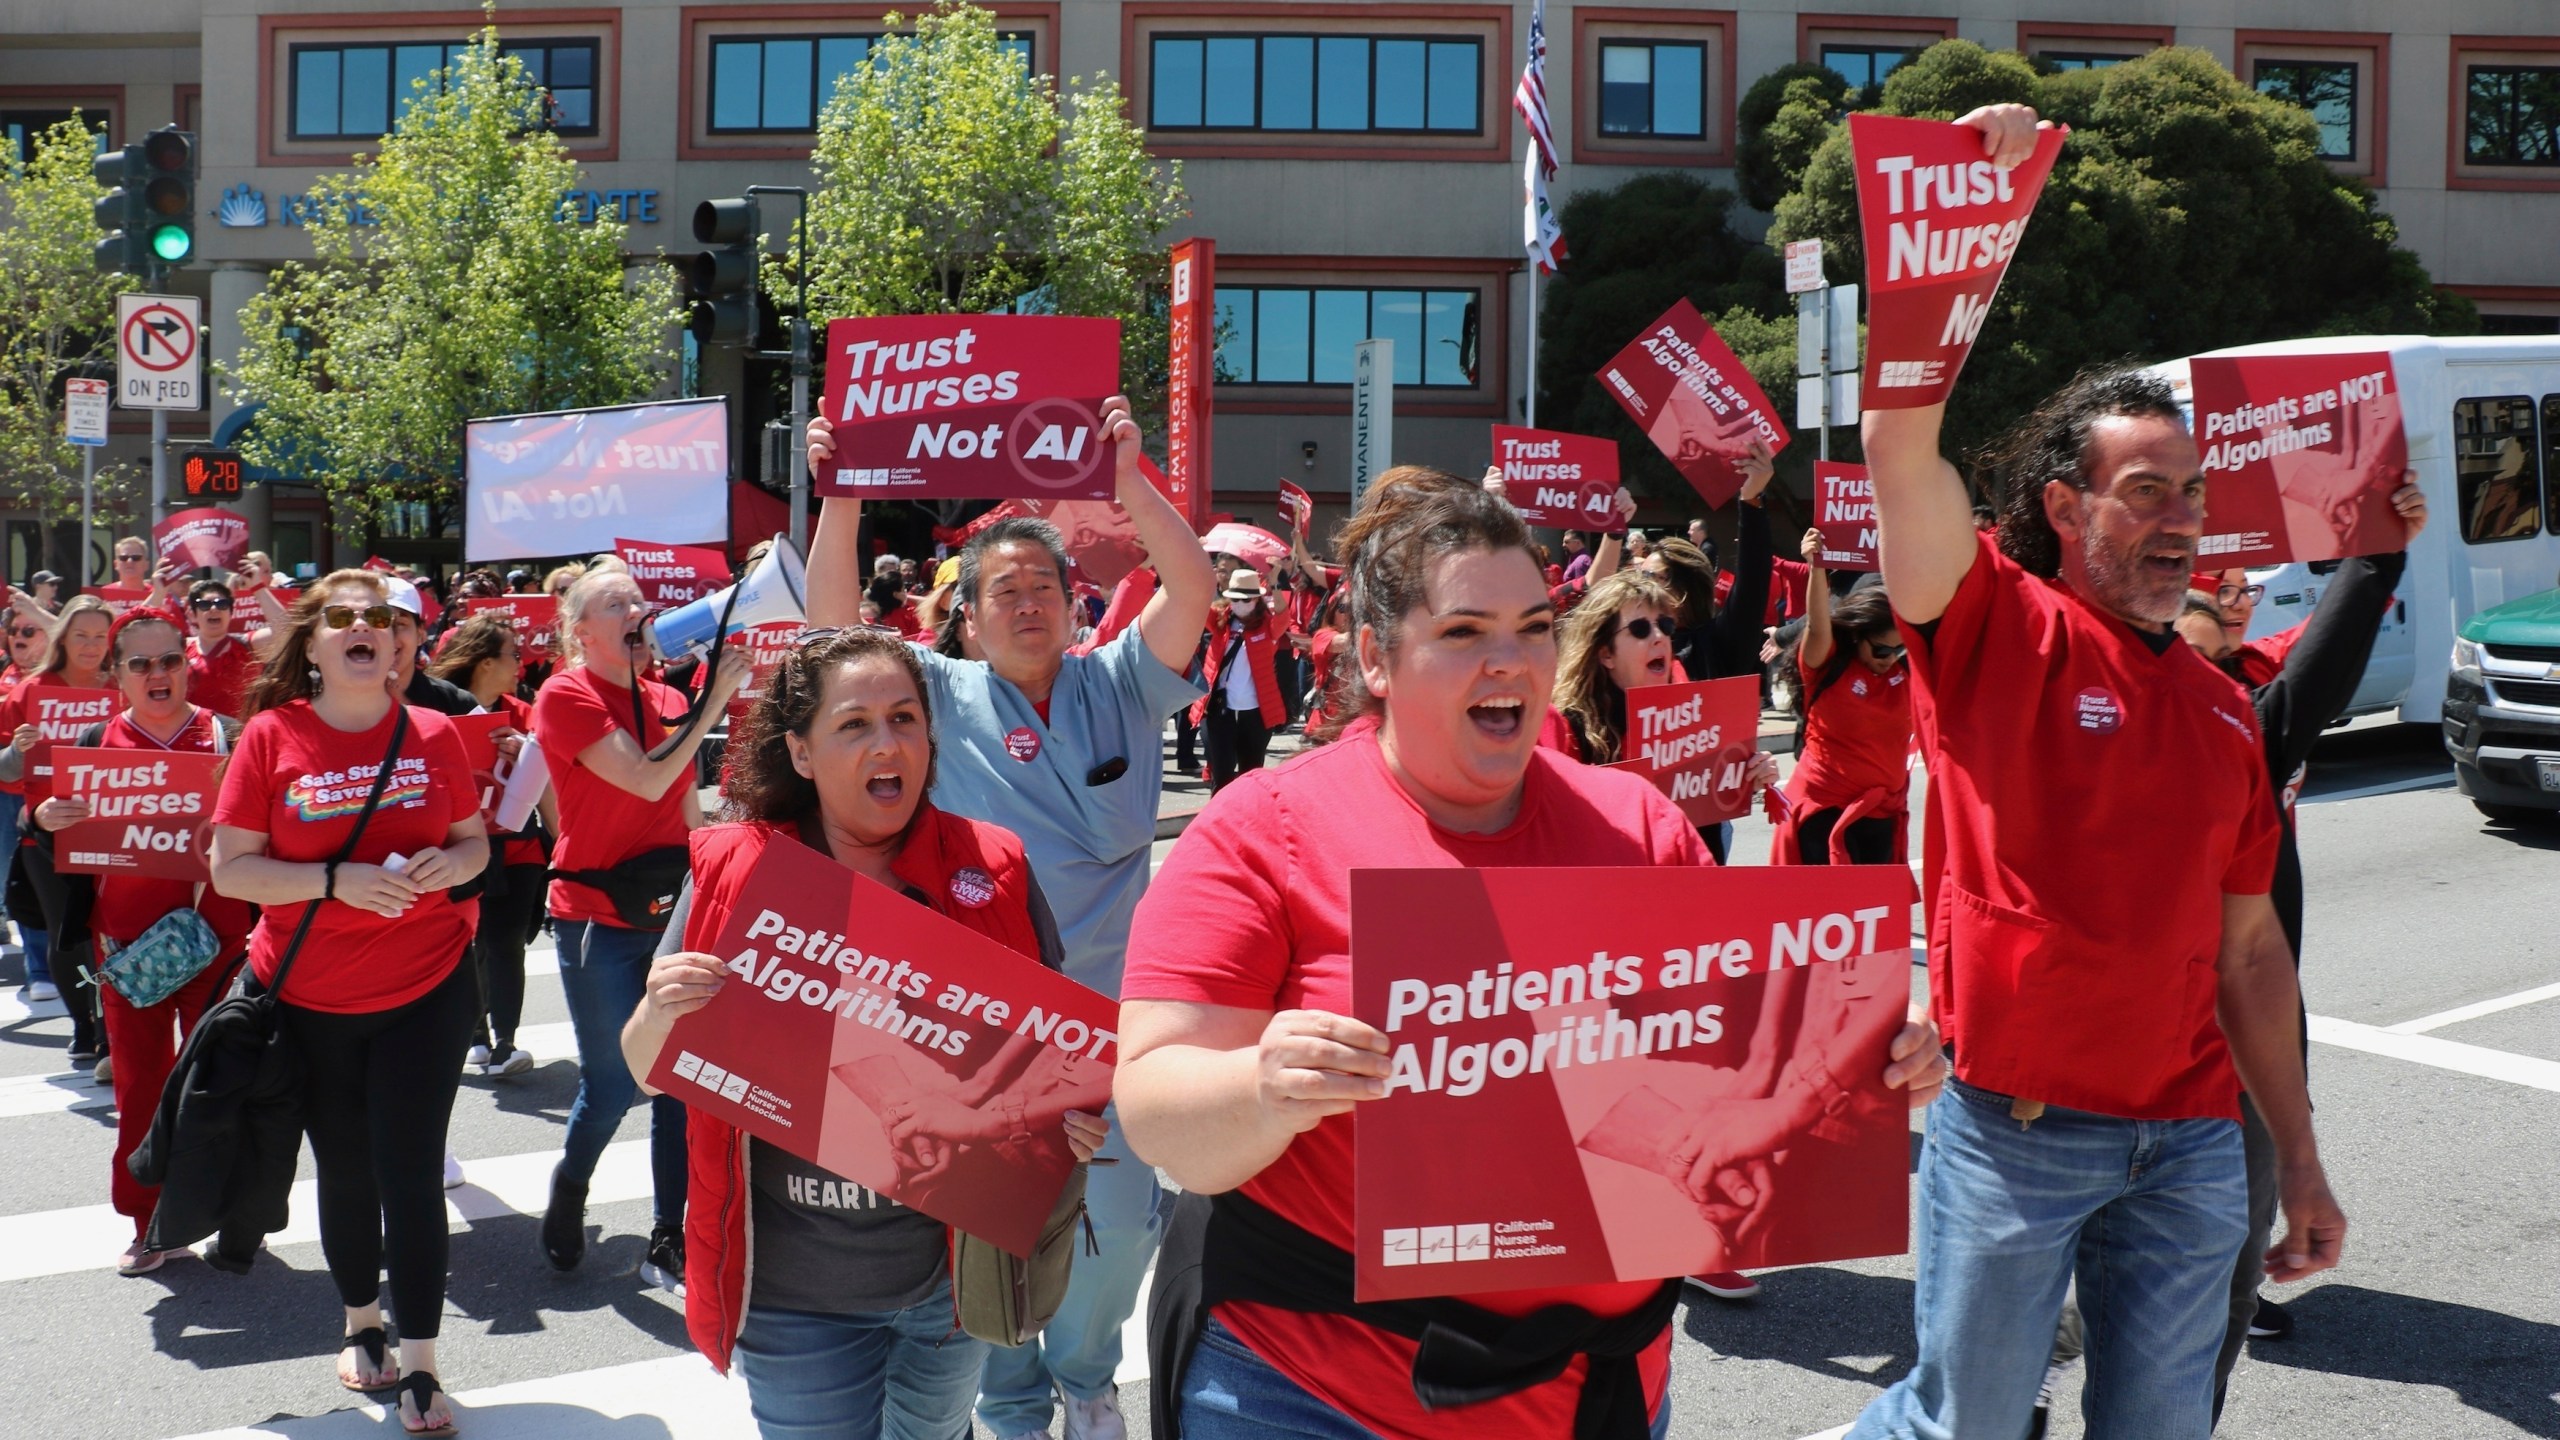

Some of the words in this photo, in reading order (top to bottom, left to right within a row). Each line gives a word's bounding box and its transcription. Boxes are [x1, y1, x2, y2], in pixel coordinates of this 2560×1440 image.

[1876, 155, 2015, 215] Trust
[1939, 293, 1989, 347] No
[846, 328, 976, 380] Trust
[129, 379, 150, 396] ON
[159, 381, 190, 398] RED
[1639, 336, 1729, 417] Algorithms
[1656, 324, 1719, 387] Patients
[1720, 382, 1749, 412] are
[1747, 409, 1781, 445] NOT
[841, 370, 1020, 422] Nurses
[1171, 319, 1182, 493] EMERGENCY
[2204, 395, 2301, 440] Patients
[2302, 388, 2338, 414] are
[2340, 371, 2387, 405] NOT
[906, 423, 1003, 460] Not
[1023, 425, 1089, 461] AI
[1357, 375, 1370, 499] RMANENTE
[1502, 438, 1561, 460] Trust
[2200, 419, 2333, 474] Algorithms
[211, 461, 239, 491] 28
[1502, 461, 1581, 481] Nurses
[1535, 487, 1577, 511] Not
[1585, 493, 1611, 514] AI
[1823, 476, 1875, 500] Trus
[1824, 499, 1878, 524] Nurs
[623, 548, 675, 564] Trust
[628, 564, 696, 579] Nurses
[658, 584, 694, 600] Not
[530, 632, 550, 646] AI
[38, 697, 112, 720] Trust
[1637, 693, 1703, 740] Trust
[38, 721, 97, 741] Nur
[1010, 734, 1030, 742] Trust
[1640, 724, 1721, 771] Nurses
[67, 761, 169, 792] Trust
[299, 771, 345, 789] Safe
[348, 757, 425, 782] Staing
[1670, 768, 1711, 801] Not
[1717, 761, 1745, 793] AI
[121, 824, 192, 854] Not
[1386, 950, 1642, 1033] Patients
[1660, 938, 1753, 989] are
[1768, 905, 1889, 972] NOT
[744, 909, 932, 999] Patients
[937, 982, 1011, 1026] are
[1016, 1004, 1117, 1061] NOT
[729, 948, 972, 1057] Algorithms
[1383, 1003, 1724, 1098] Algorithms
[747, 1093, 777, 1111] Nurses
[751, 1085, 792, 1110] California
[743, 1101, 793, 1128] Association
[786, 1174, 878, 1210] HEART
[1494, 1219, 1555, 1234] California
[1494, 1234, 1538, 1246] Nurses
[1493, 1244, 1566, 1259] Association
